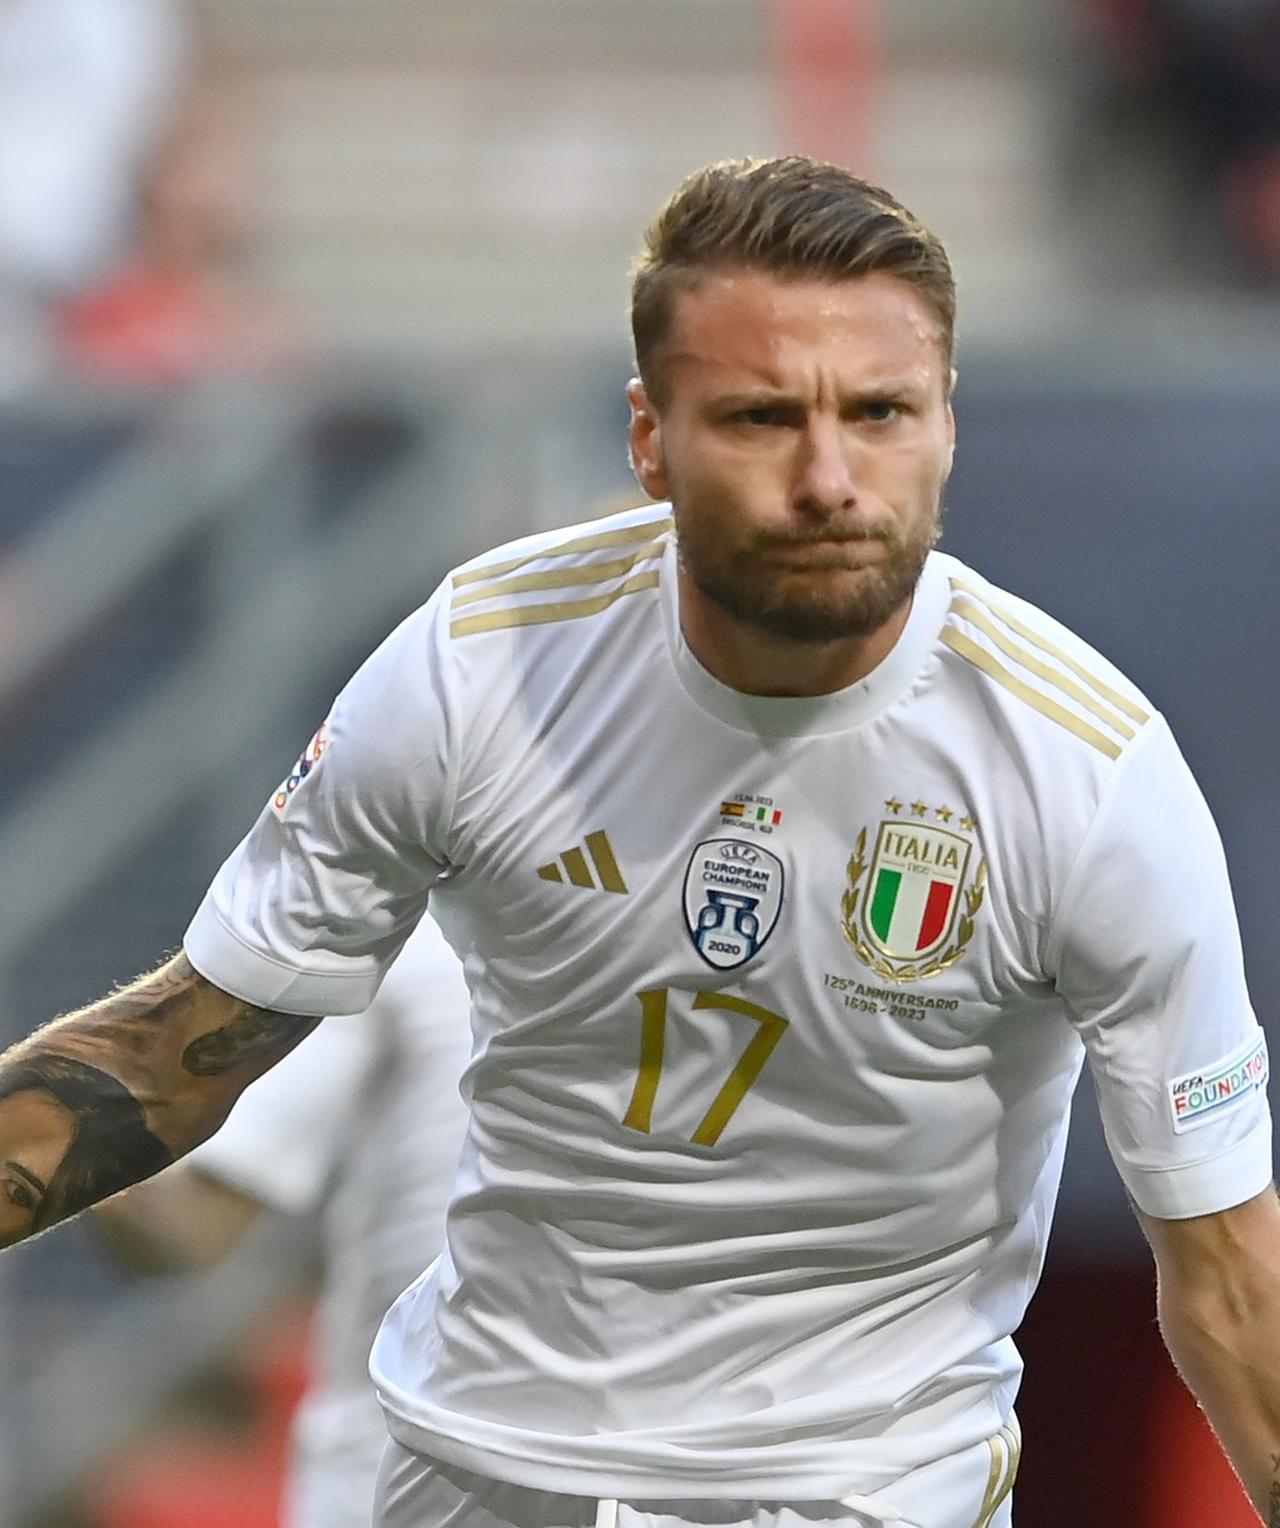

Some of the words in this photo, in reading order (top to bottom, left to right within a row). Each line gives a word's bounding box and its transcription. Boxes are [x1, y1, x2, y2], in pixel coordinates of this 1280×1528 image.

[720, 846, 759, 864] UEFA
[883, 831, 959, 869] ITALIA
[704, 860, 770, 881] EUROPEAN
[703, 871, 767, 892] CHAMPIONS
[708, 940, 741, 955] 2020
[854, 983, 959, 1010] ANNIVERSARIO
[888, 1004, 926, 1021] 2023
[622, 987, 791, 1148] 17
[1172, 1075, 1203, 1095] UEFA
